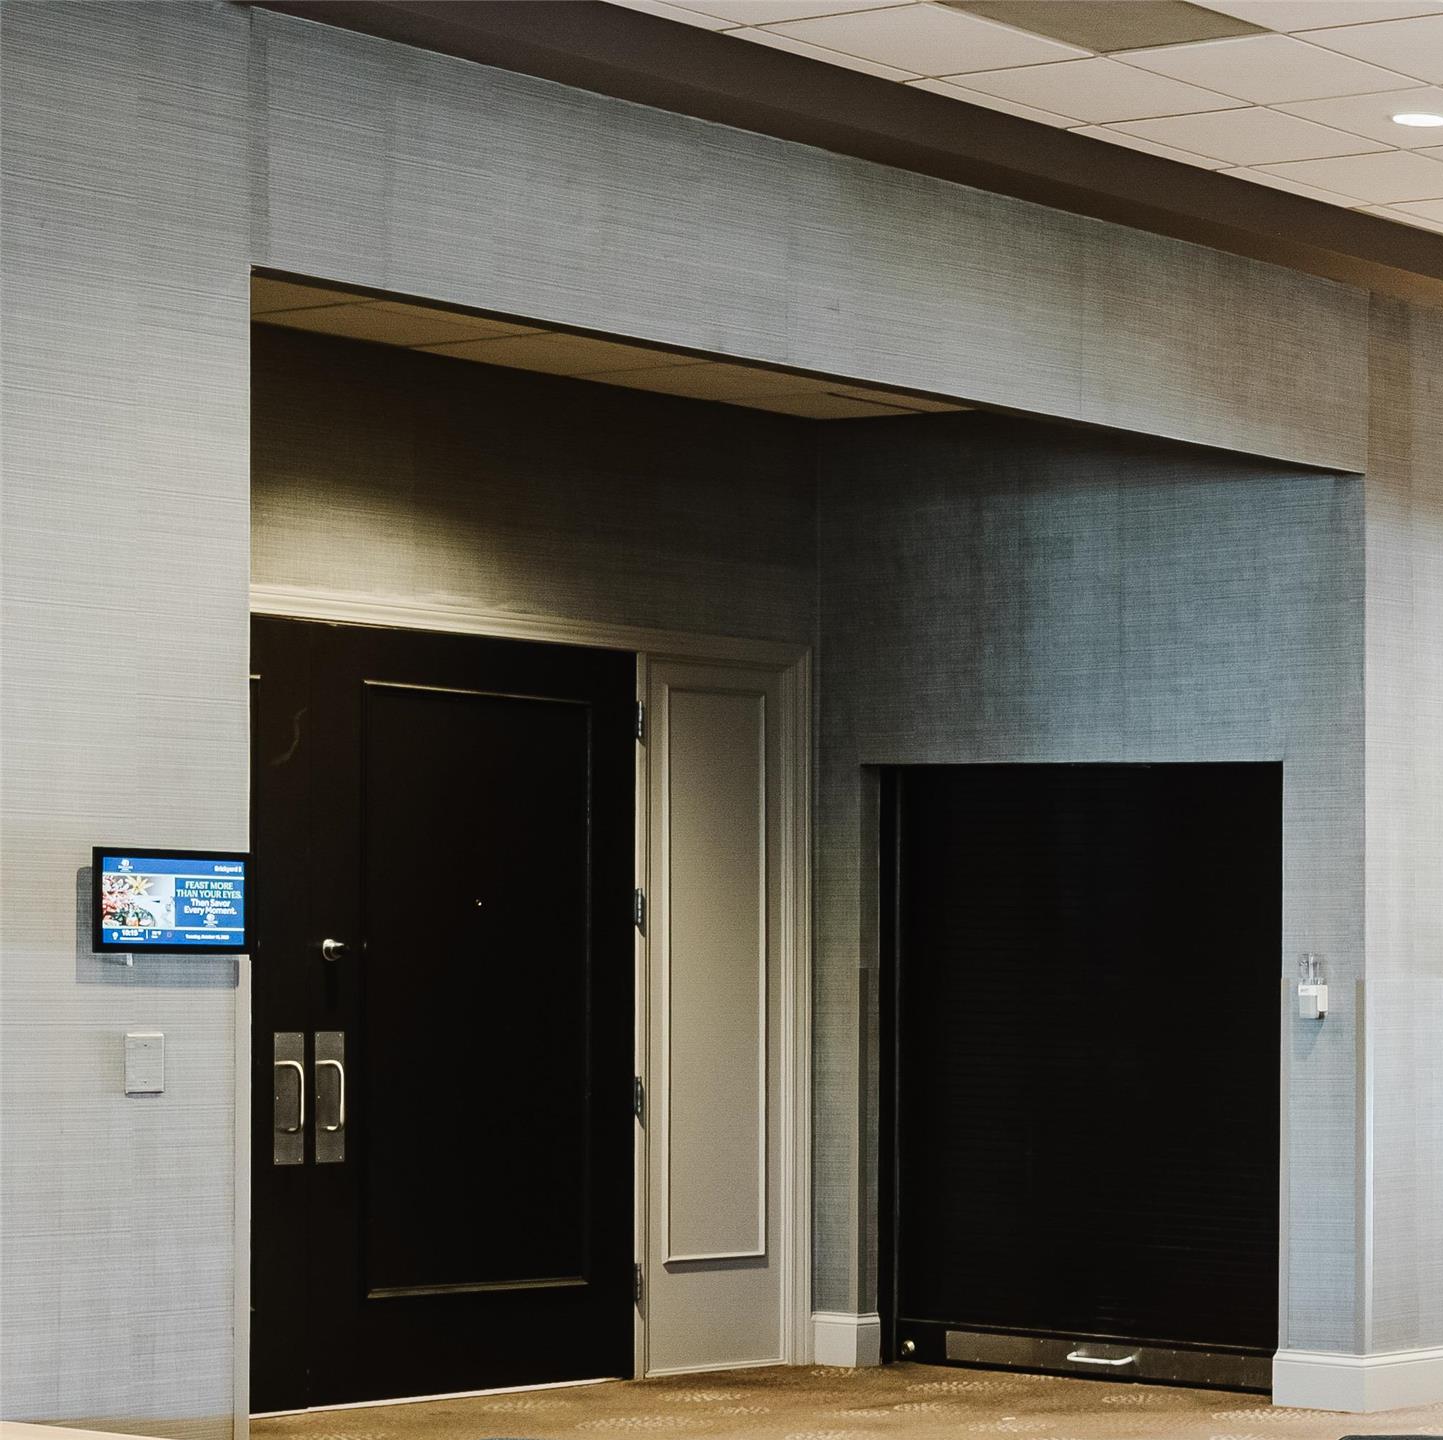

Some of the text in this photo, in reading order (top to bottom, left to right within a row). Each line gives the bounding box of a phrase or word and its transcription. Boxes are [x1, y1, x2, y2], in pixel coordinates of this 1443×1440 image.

[185, 880, 233, 890] FEAST MORE
[176, 889, 198, 898] THAN
[199, 890, 221, 898] YOUR
[190, 898, 231, 907] Then Savor
[184, 906, 237, 916] Every Moment.
